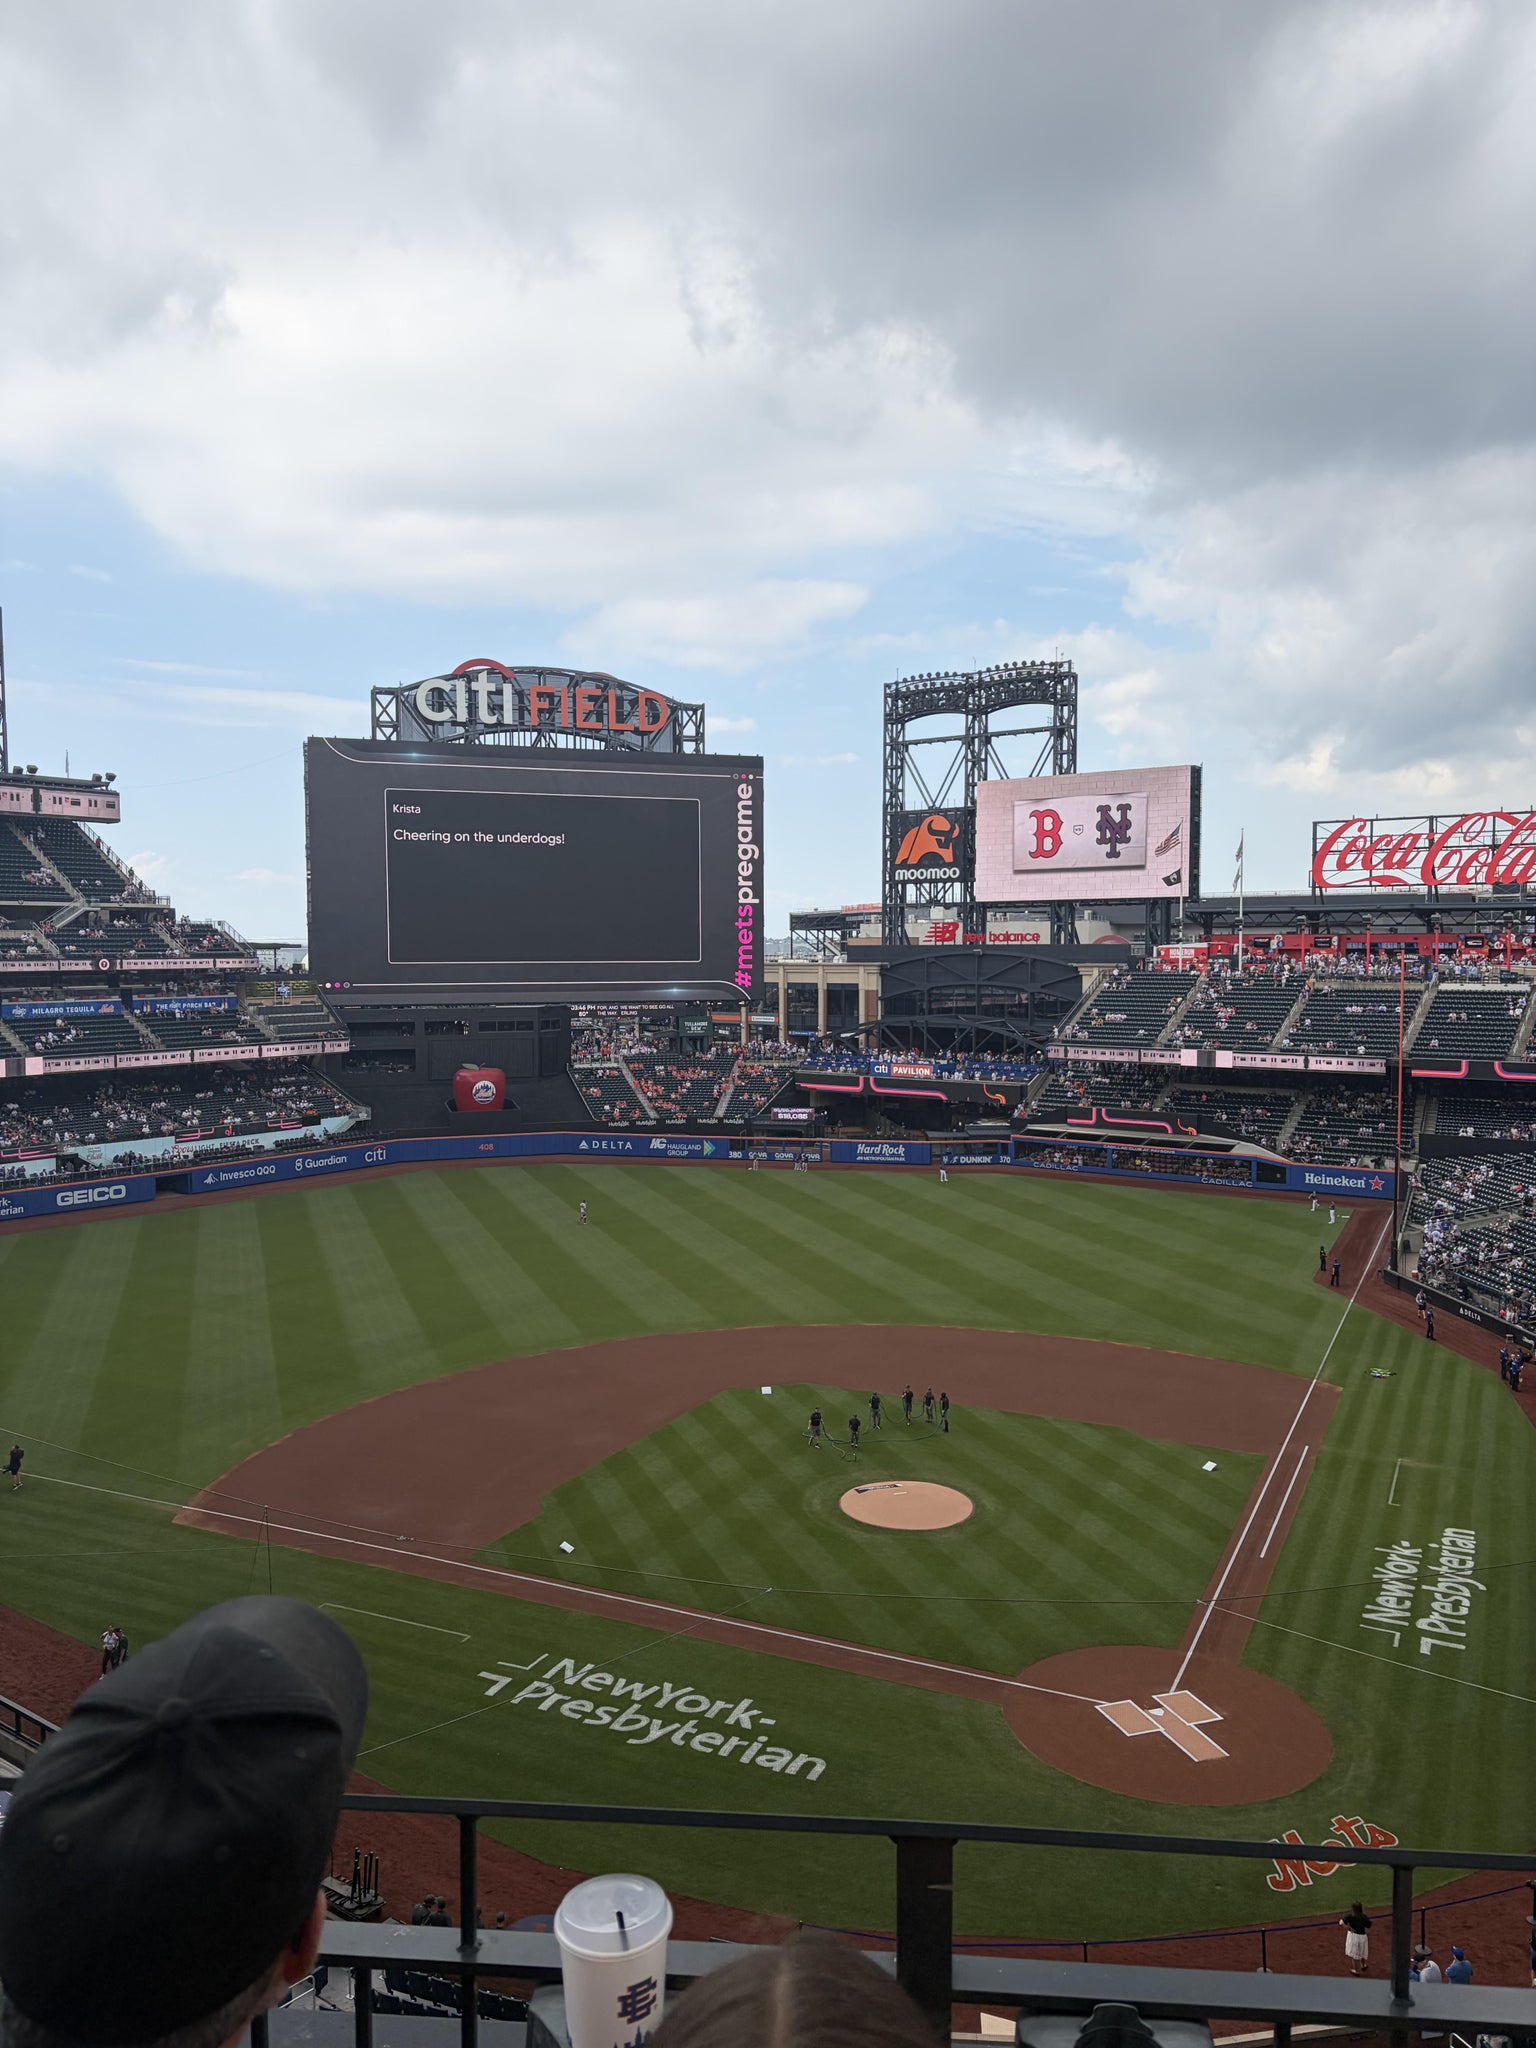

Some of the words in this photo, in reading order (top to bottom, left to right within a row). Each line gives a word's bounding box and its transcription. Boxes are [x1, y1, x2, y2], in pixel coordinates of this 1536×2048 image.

[415, 671, 513, 725] citi
[529, 685, 669, 732] FIELD
[393, 804, 421, 814] Krista
[393, 829, 451, 844] Cheering
[454, 833, 470, 842] on
[473, 832, 494, 843] the
[497, 832, 566, 846] underdogs!
[1029, 809, 1064, 859] B
[895, 867, 960, 881] moomoo
[735, 783, 760, 988] #metspregame
[961, 933, 986, 943] new
[989, 930, 1041, 943] balance
[32, 1007, 64, 1015] MILAGRO
[66, 1006, 95, 1014] TEQUILA
[874, 1065, 888, 1073] citi
[893, 1066, 930, 1076] PAVILION
[592, 1140, 633, 1150] DELTA
[667, 1143, 701, 1151] HAUGLAND
[857, 1143, 881, 1154] Hard
[882, 1144, 905, 1157] Rock
[305, 1155, 347, 1168] Guardian
[364, 1148, 386, 1162] citi
[960, 1155, 993, 1164] DUNKIN'
[1000, 1155, 1011, 1163] 370
[220, 1169, 255, 1181] Invesco
[257, 1165, 276, 1176] QQQ
[1033, 1161, 1079, 1171] CADILLAC
[1201, 1177, 1253, 1188] CADILLAC
[1305, 1172, 1366, 1188] Heineken
[57, 1185, 126, 1206] GEICO
[1464, 1310, 1481, 1321] DELTA
[1362, 1540, 1423, 1627] NewYork-
[1415, 1527, 1487, 1638] Presbyterian
[542, 1658, 776, 1731] NewYork-
[510, 1680, 828, 1782] Presbyterian
